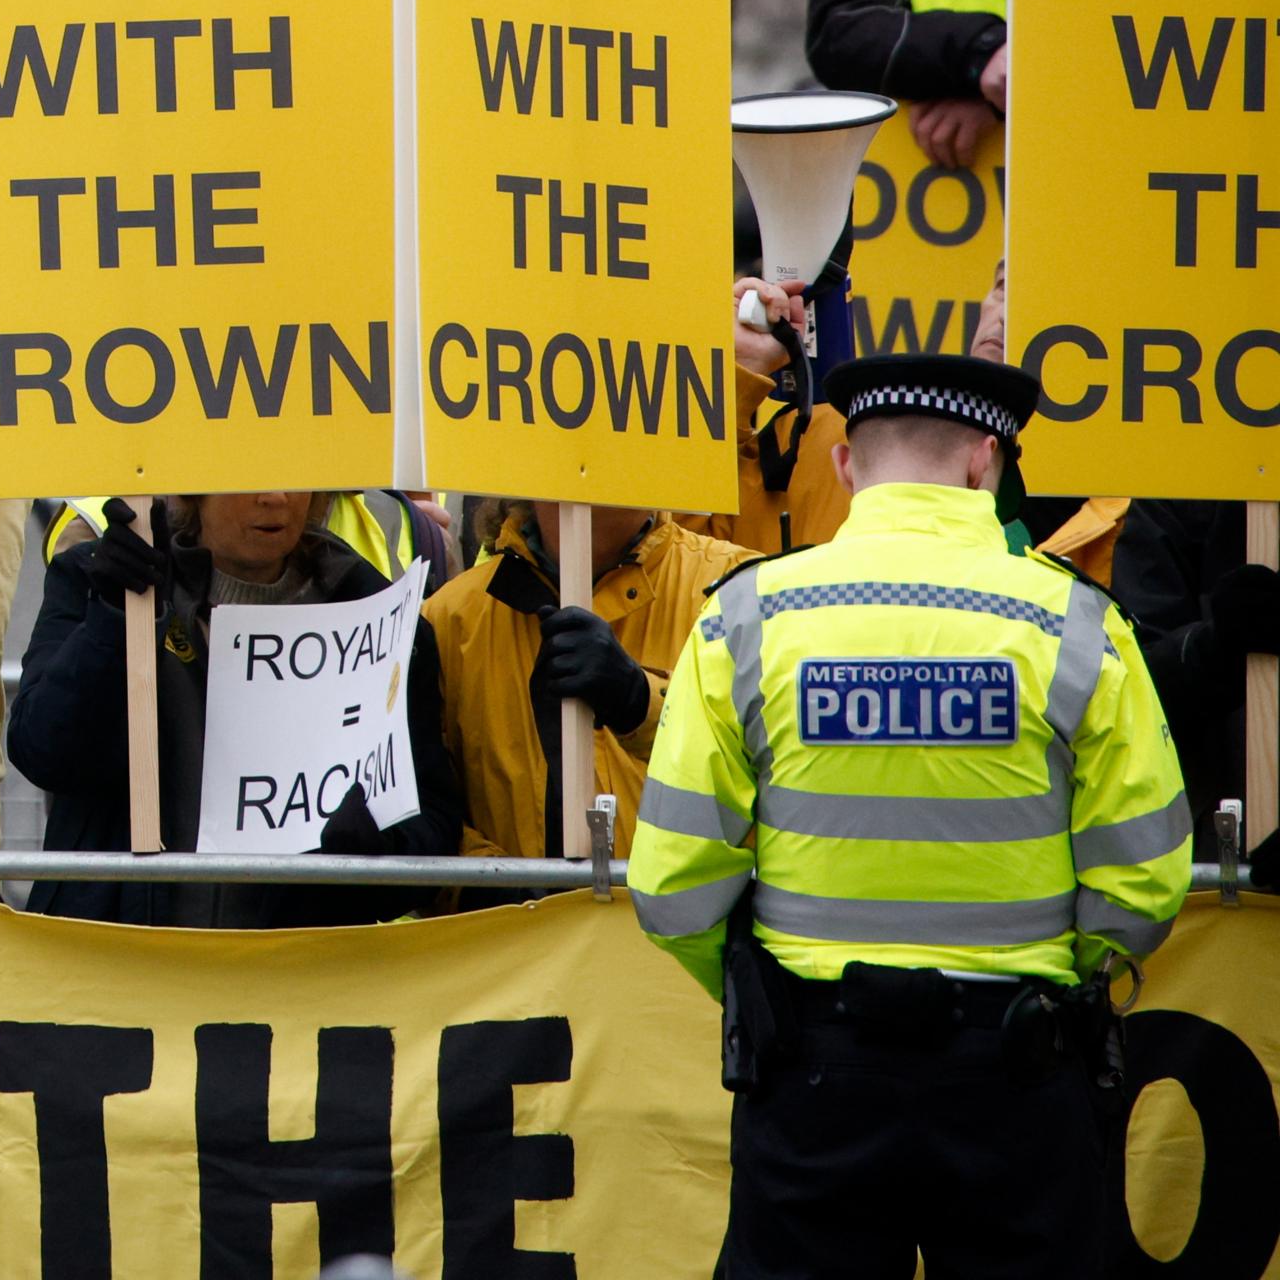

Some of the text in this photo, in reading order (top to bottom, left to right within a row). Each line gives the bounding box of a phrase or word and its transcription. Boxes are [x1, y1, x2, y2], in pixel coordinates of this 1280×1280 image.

[472, 18, 667, 127] WITH
[10, 172, 264, 270] THE
[497, 175, 649, 279] THE
[430, 323, 725, 440] CROWN
[1021, 325, 1280, 427] CRO
[806, 665, 1009, 683] METROPOLITAN
[806, 687, 1009, 736] POLICE
